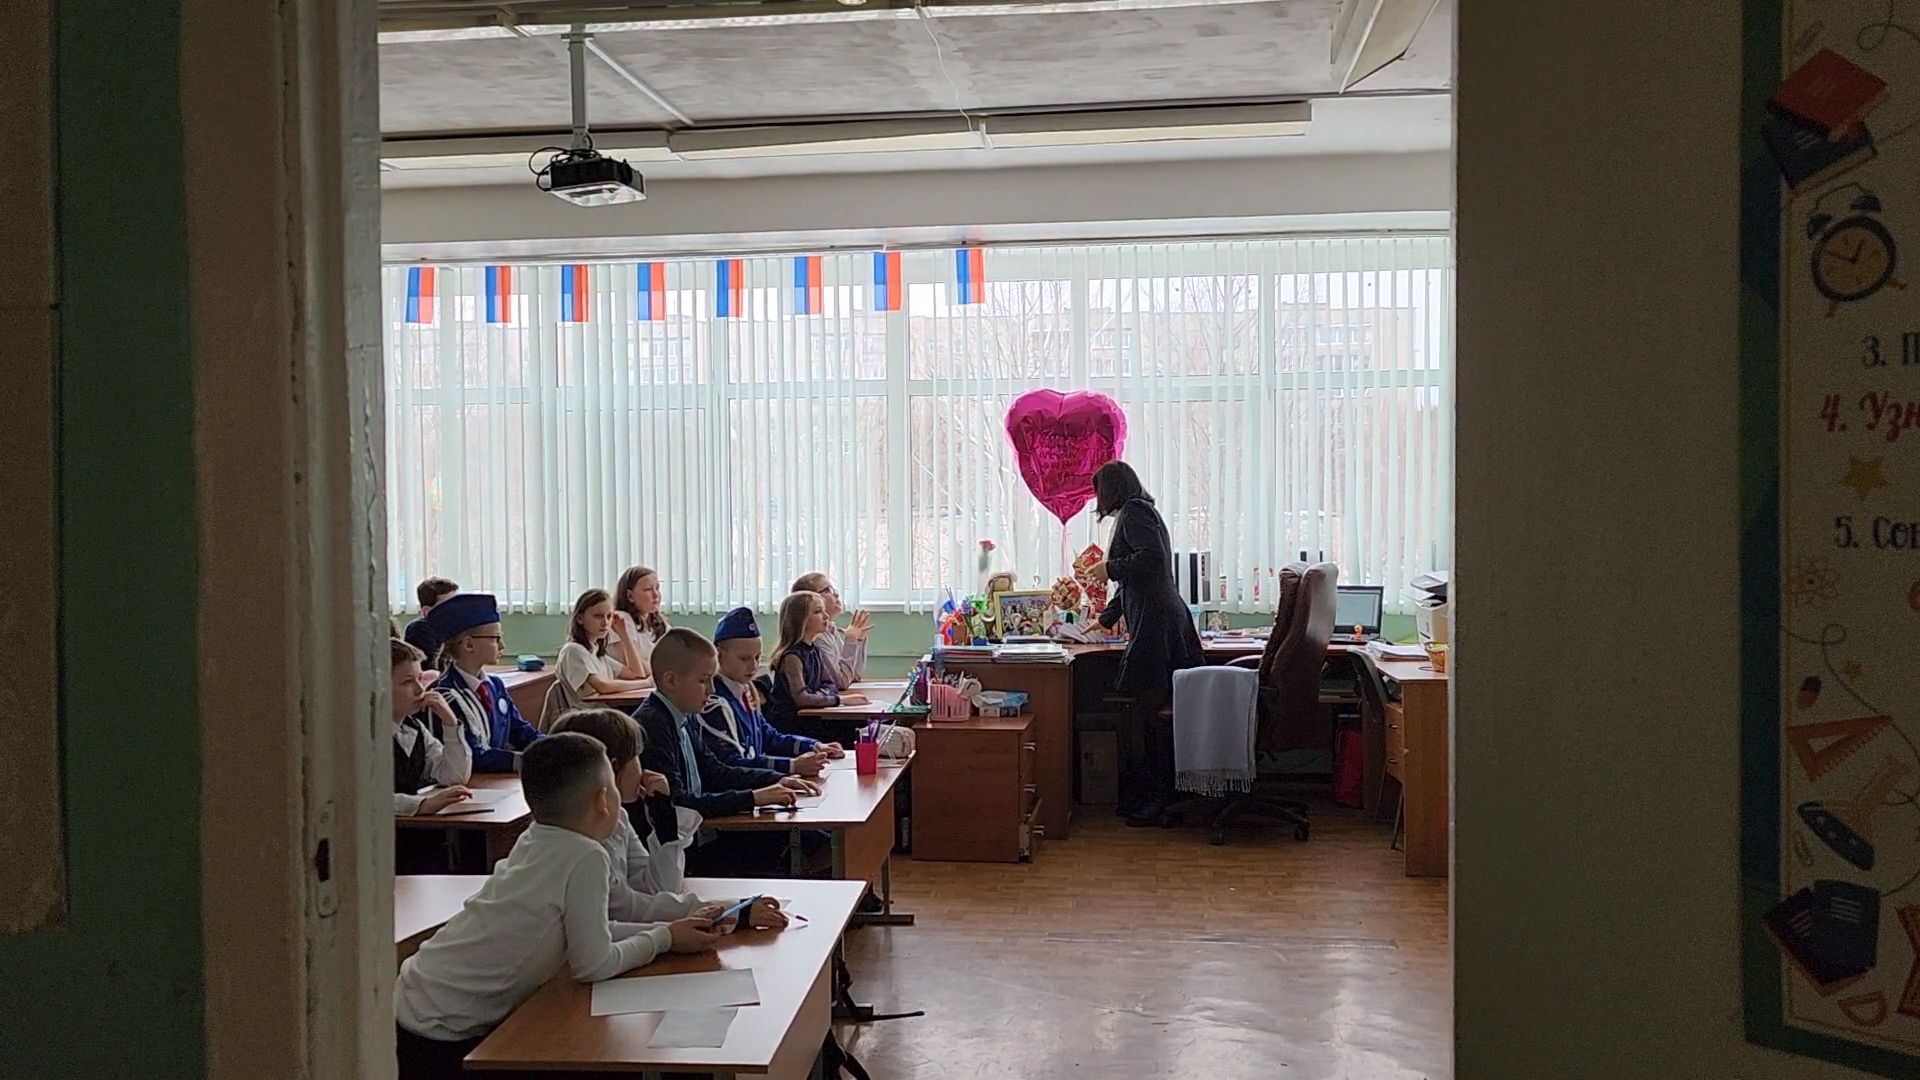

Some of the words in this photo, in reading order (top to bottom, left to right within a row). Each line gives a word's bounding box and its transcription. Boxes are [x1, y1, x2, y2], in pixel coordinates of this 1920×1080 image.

[1862, 335, 1887, 367] 3.
[1821, 394, 1848, 432] 4.
[1834, 516, 1859, 549] 5.
